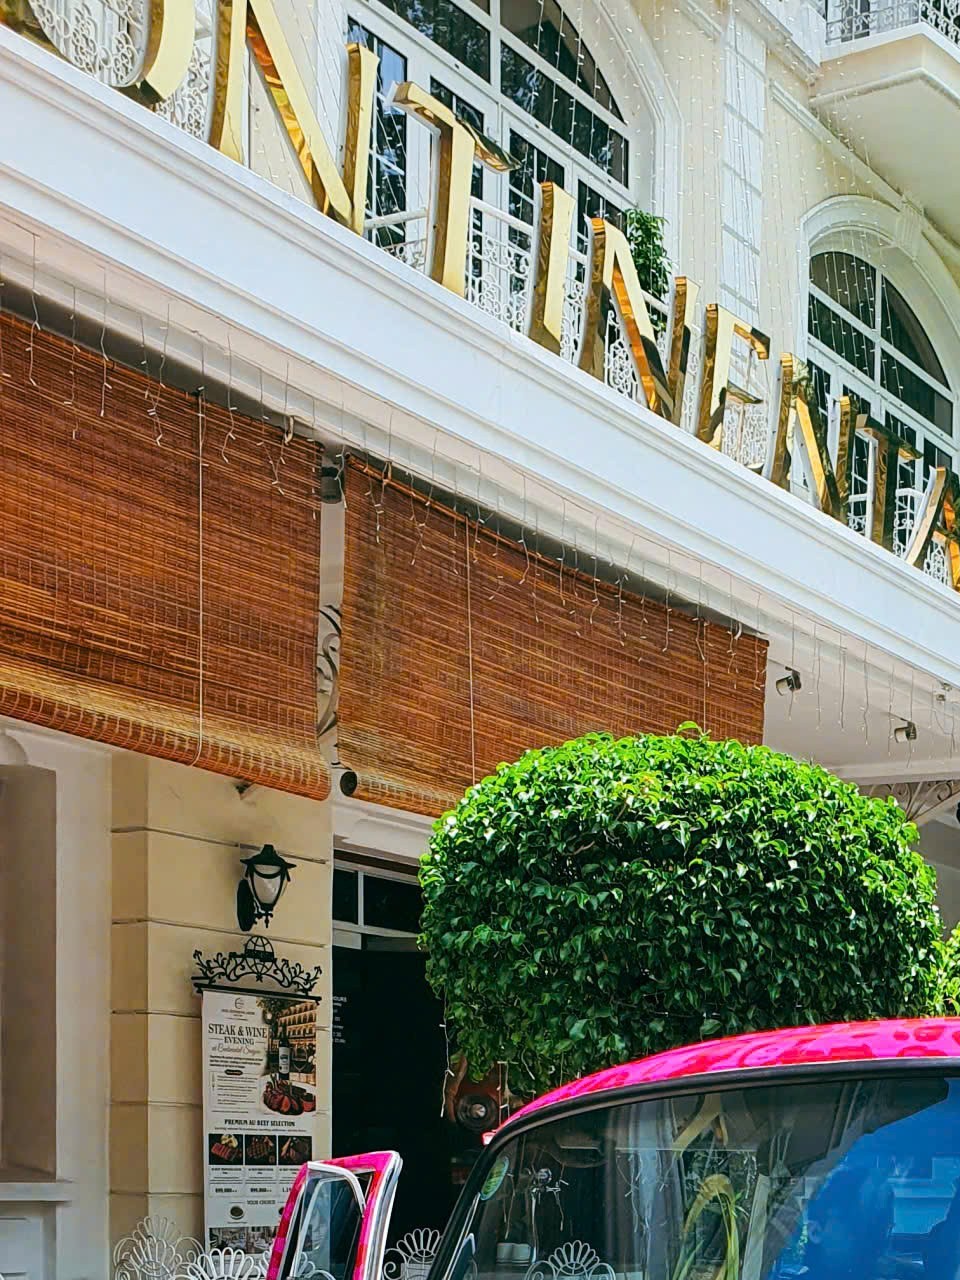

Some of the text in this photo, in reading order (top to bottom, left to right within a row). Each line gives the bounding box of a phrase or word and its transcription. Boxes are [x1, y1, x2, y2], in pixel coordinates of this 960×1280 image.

[208, 1023, 268, 1039] STEAK & WINE
[224, 1036, 255, 1046] EVENING
